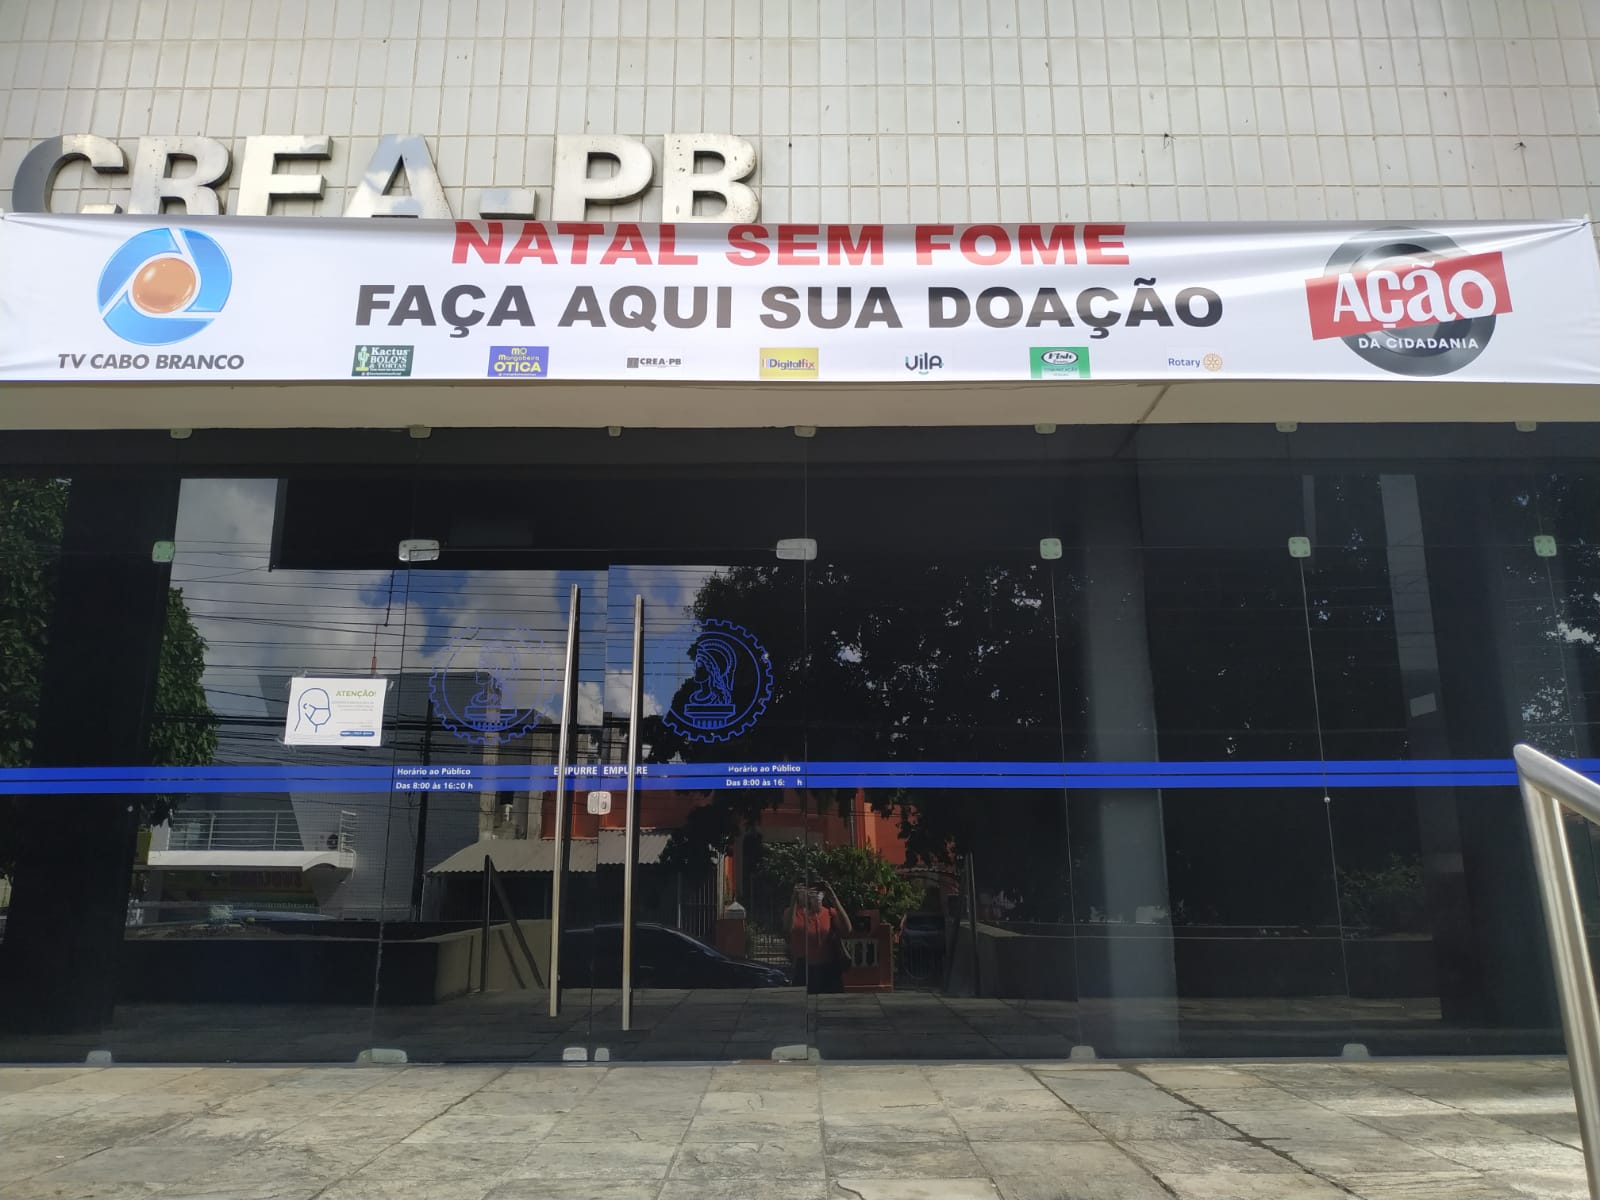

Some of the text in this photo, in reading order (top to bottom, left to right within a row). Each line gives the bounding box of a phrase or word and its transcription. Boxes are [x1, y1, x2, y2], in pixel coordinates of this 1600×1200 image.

[451, 221, 1130, 267] NATAL SEM FOME
[355, 276, 1224, 340] FAÇA AQUI SUA DOAÇÃO
[1358, 337, 1479, 350] DA CIDADANIA
[370, 346, 408, 356] Kactus
[58, 353, 244, 370] TV CABO BRANCO
[1168, 357, 1200, 368] Rotary
[397, 767, 427, 776] Horário
[441, 767, 471, 776] Público
[603, 766, 648, 775] EMPURE
[728, 764, 758, 773] Horário
[771, 764, 801, 773] Público
[395, 782, 411, 790] Das
[412, 782, 430, 790] 8:00
[432, 781, 441, 790] às
[467, 782, 473, 790] h
[726, 779, 741, 787] Das
[762, 778, 771, 786] às
[797, 778, 803, 786] h
